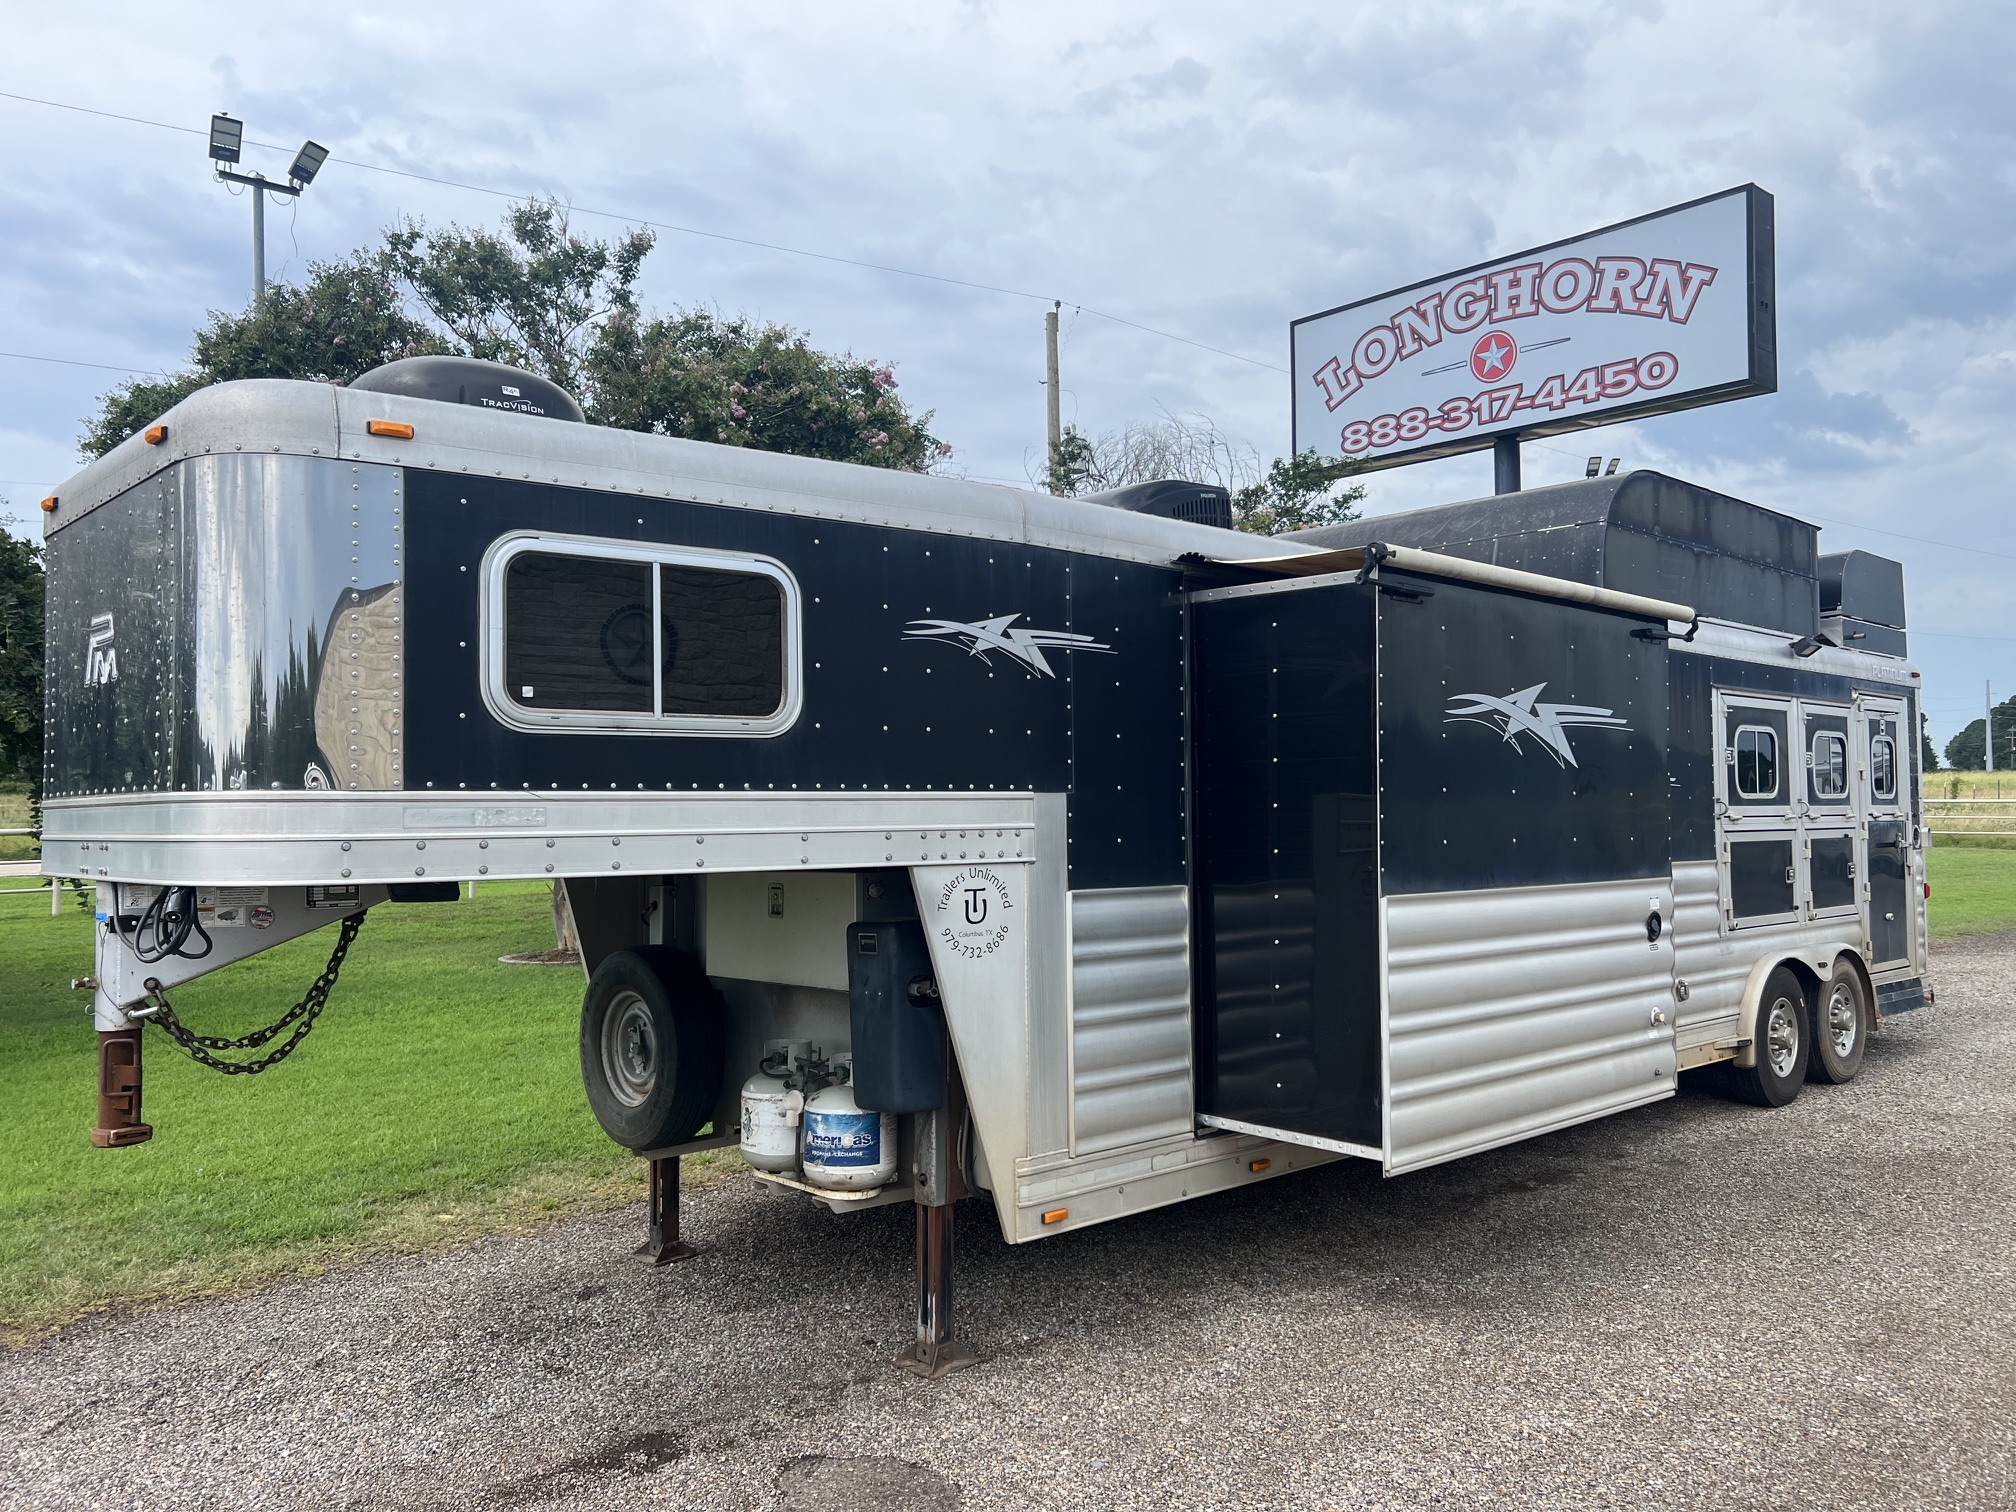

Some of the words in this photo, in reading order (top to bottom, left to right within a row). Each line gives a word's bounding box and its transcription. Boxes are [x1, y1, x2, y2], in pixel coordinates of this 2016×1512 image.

[1313, 256, 1718, 413] LONGHORN
[1341, 352, 1678, 453] 888-317-4450
[938, 873, 965, 912] Trailers
[969, 867, 1013, 909] Unlimited
[941, 925, 1009, 958] 979-732-8686
